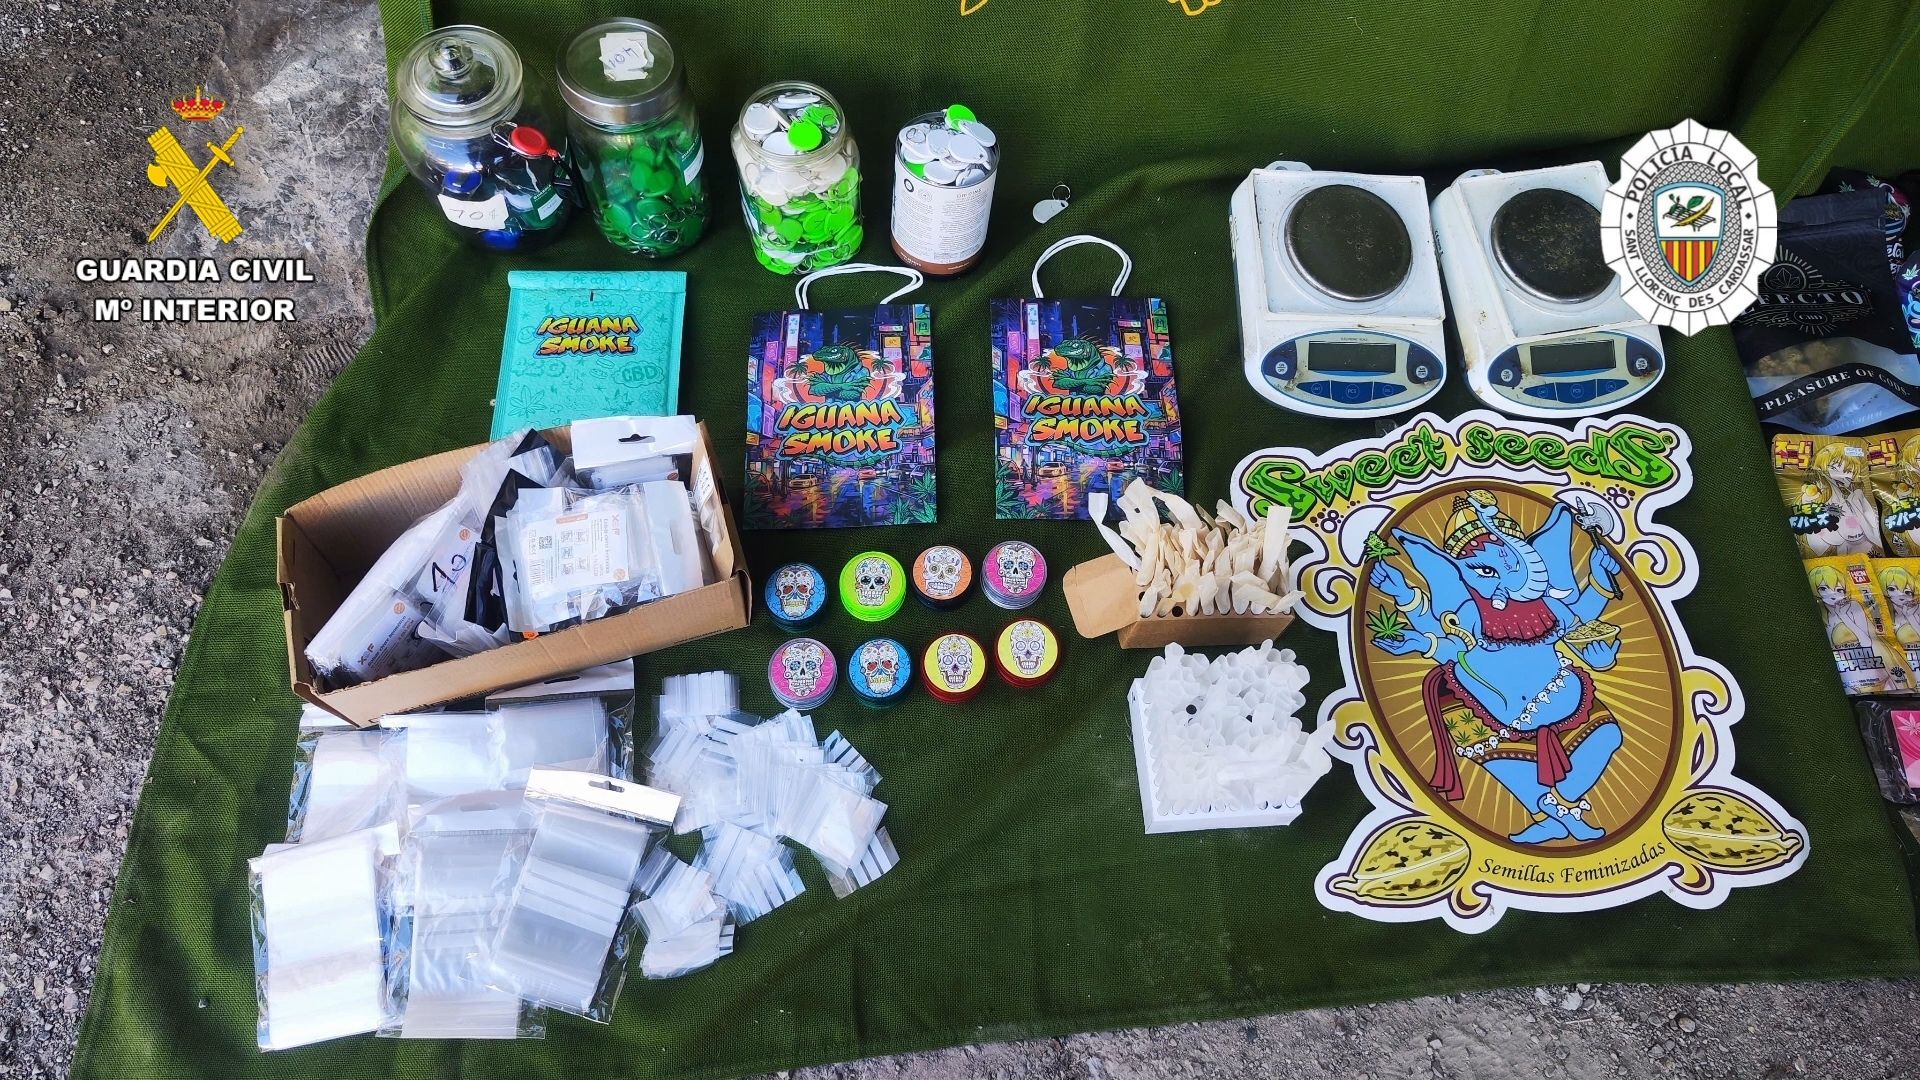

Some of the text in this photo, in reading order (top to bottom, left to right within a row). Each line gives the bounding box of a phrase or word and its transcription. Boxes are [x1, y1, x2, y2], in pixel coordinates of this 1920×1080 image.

[536, 316, 641, 335] IGUANA
[536, 335, 637, 356] SMOKE
[622, 365, 657, 382] CBD
[1856, 368, 1875, 378] OF
[778, 400, 901, 431] IGUANA
[1025, 395, 1148, 416] IGUANA
[1032, 417, 1145, 443] SMOKE
[779, 427, 898, 457] SMOKE
[1247, 425, 1447, 523] Sweet
[1478, 841, 1666, 884] Semillas Feminizadas
